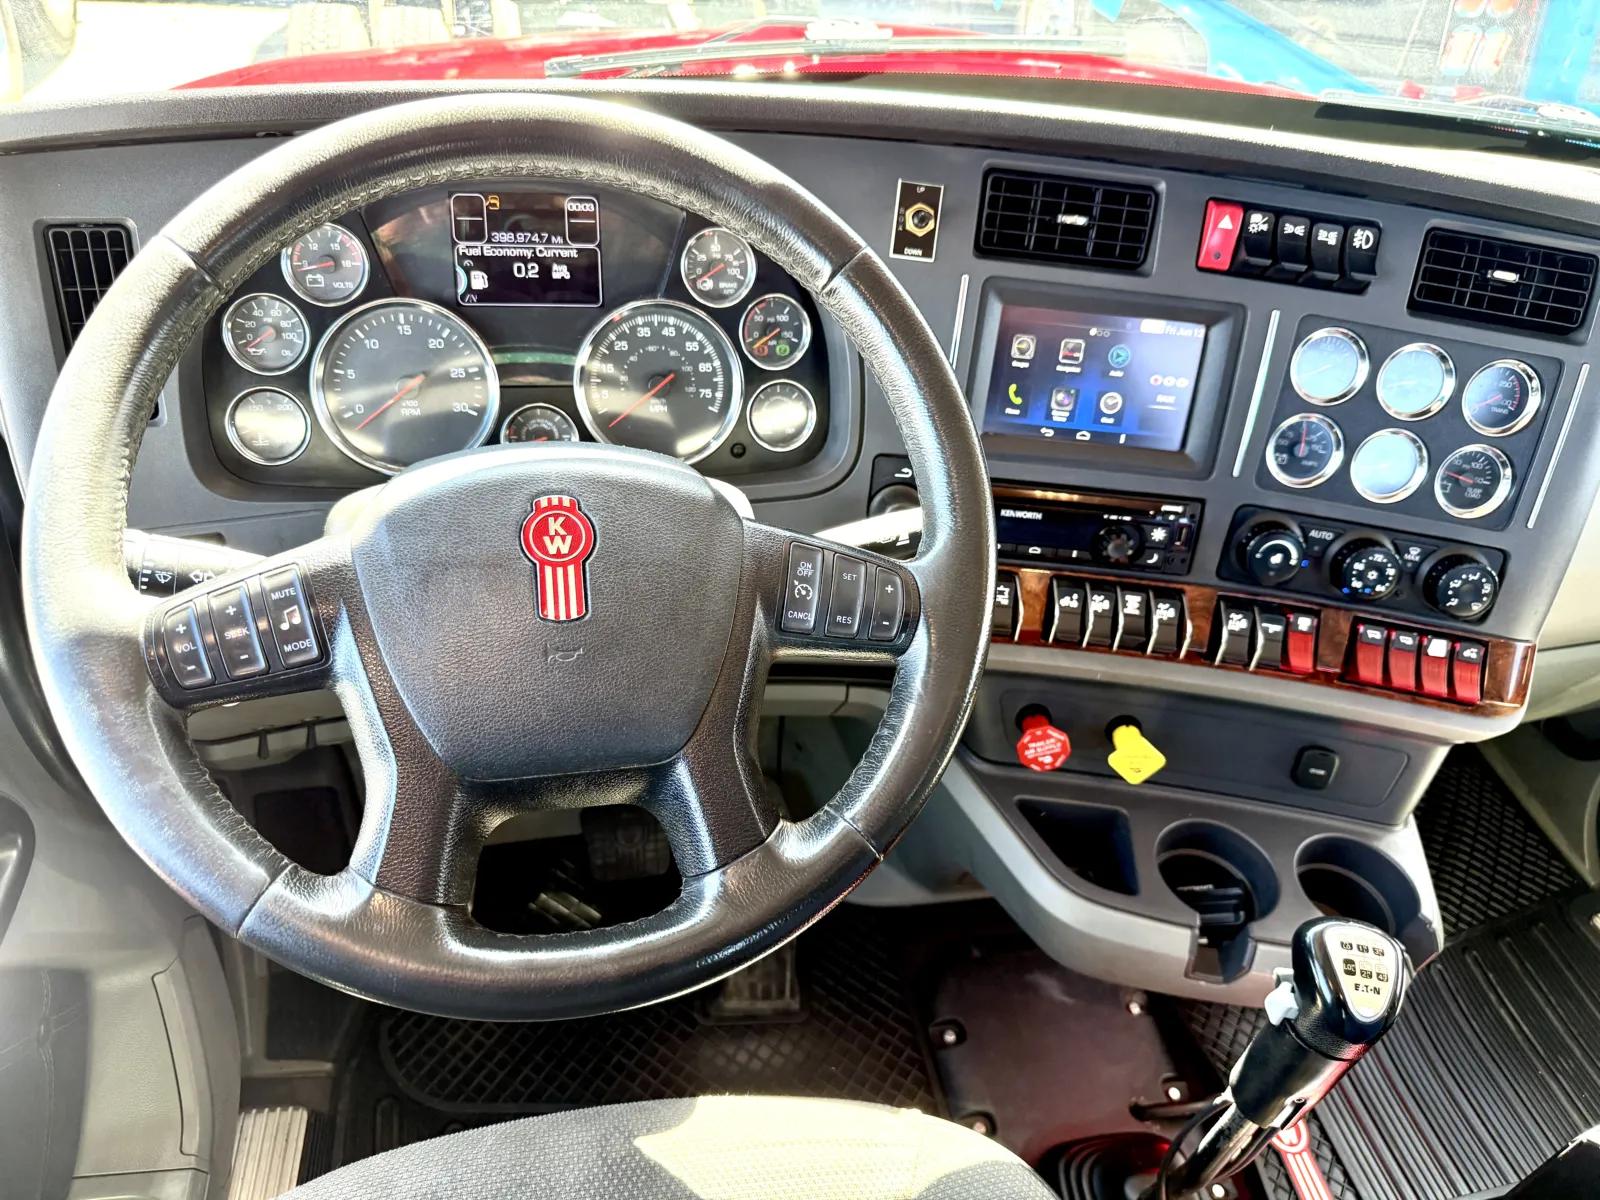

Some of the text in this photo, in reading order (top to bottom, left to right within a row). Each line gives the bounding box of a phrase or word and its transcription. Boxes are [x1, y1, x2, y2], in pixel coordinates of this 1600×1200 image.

[458, 246, 482, 256] Fuel
[535, 247, 579, 258] Current
[512, 263, 540, 279] 0.2
[397, 325, 412, 336] 15
[636, 328, 651, 338] 35
[661, 328, 676, 337] 45
[363, 338, 379, 350] 10
[428, 338, 445, 349] 20
[614, 340, 628, 351] 25
[685, 341, 699, 352] 55
[450, 368, 466, 378] 25
[698, 363, 713, 373] 65
[346, 369, 356, 379] 5
[698, 388, 713, 399] 75
[356, 403, 365, 414] 0
[453, 402, 469, 413] 30
[1000, 508, 1043, 520] KENWORTH
[547, 516, 568, 536] K
[1308, 529, 1334, 541] AUTO
[543, 535, 573, 555] W
[799, 561, 812, 569] ON
[797, 569, 814, 577] OFF
[842, 572, 857, 580] SET
[270, 587, 297, 601] MUTE
[787, 610, 812, 620] CANCL
[836, 615, 853, 625] RES
[224, 627, 250, 640] SEEK
[174, 641, 197, 653] VOL
[283, 639, 313, 653] MODE
